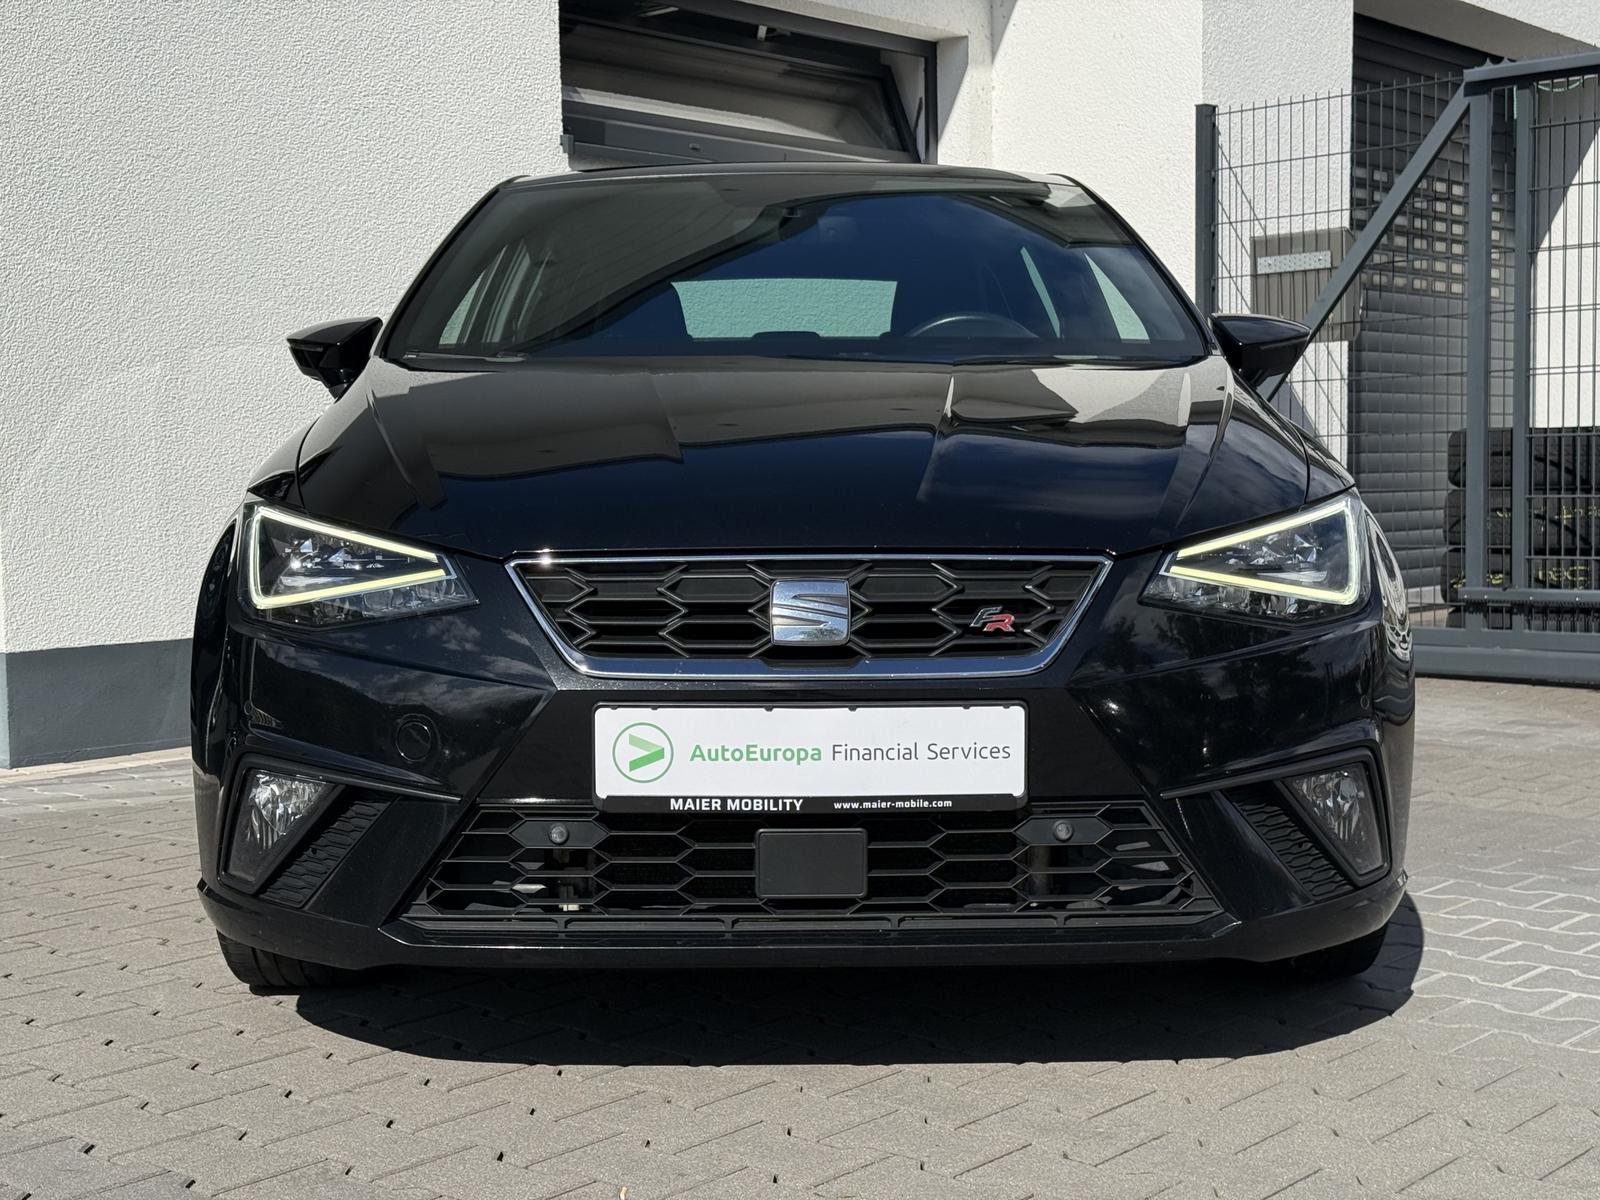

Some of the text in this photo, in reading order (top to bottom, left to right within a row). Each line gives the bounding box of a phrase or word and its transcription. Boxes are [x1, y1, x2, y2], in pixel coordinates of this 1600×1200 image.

[969, 605, 1016, 632] FR
[690, 742, 1011, 765] AutoEuropa Financial Services
[670, 799, 804, 811] MAIER MOBILITY
[833, 799, 953, 810] www.maier-mobile.com
